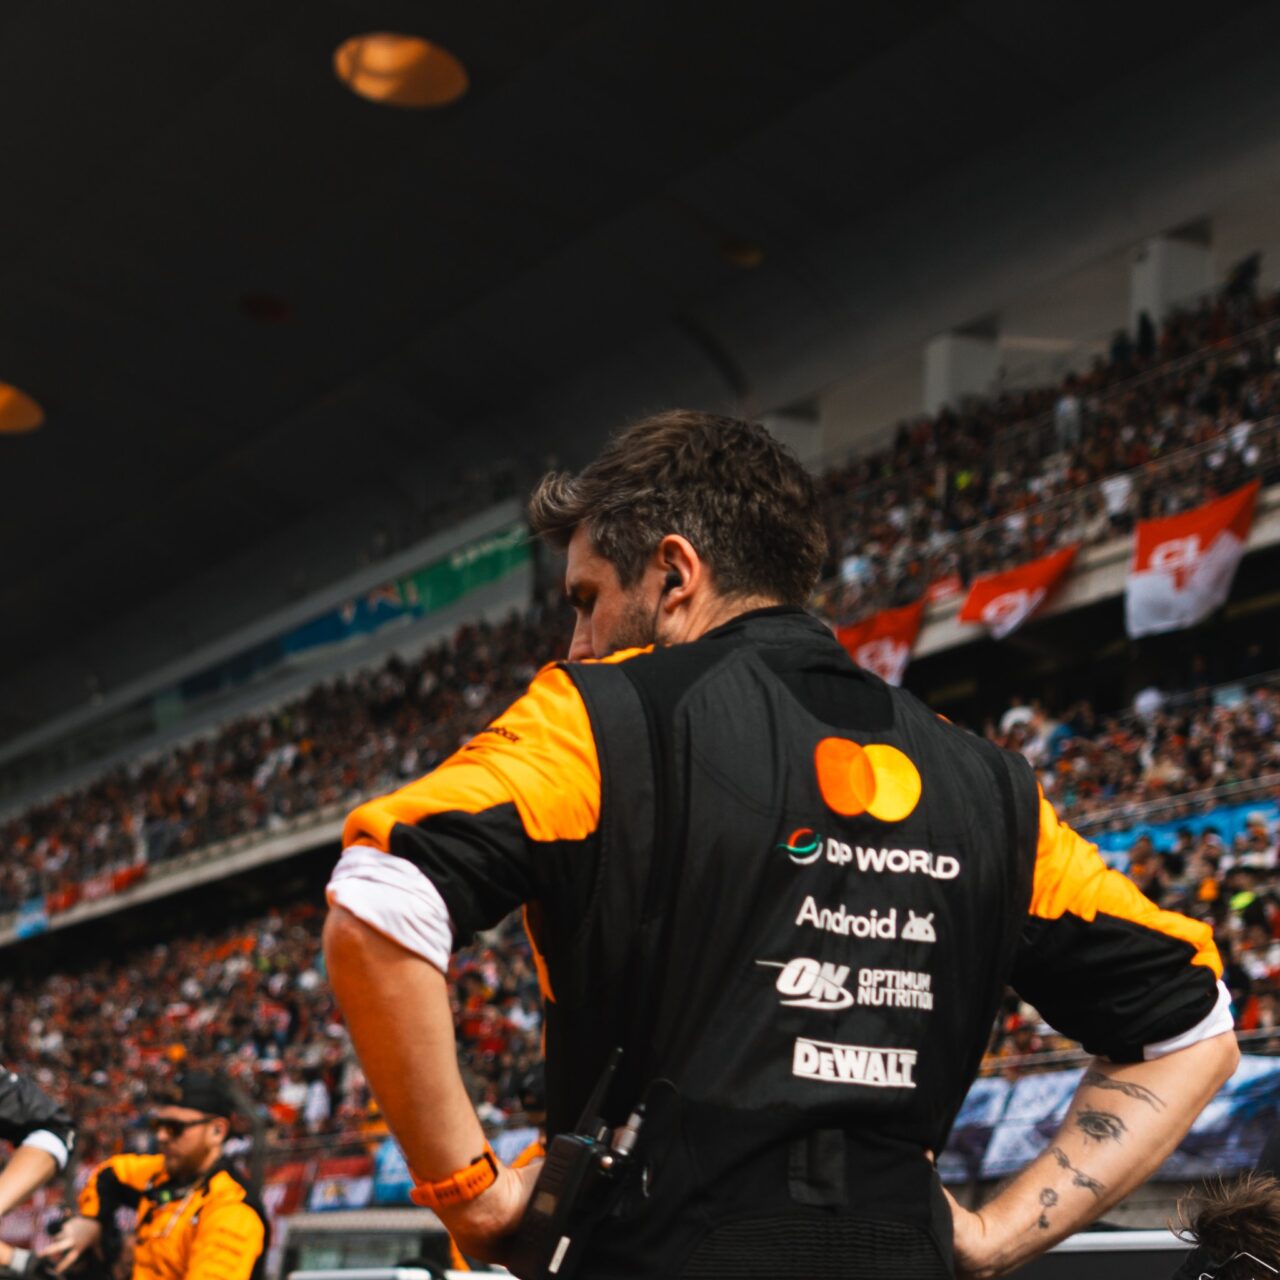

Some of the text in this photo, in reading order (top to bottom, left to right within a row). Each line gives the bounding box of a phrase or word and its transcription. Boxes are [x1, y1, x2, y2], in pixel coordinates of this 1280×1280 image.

[826, 837, 960, 880] DP WORLD
[795, 896, 898, 940] Android
